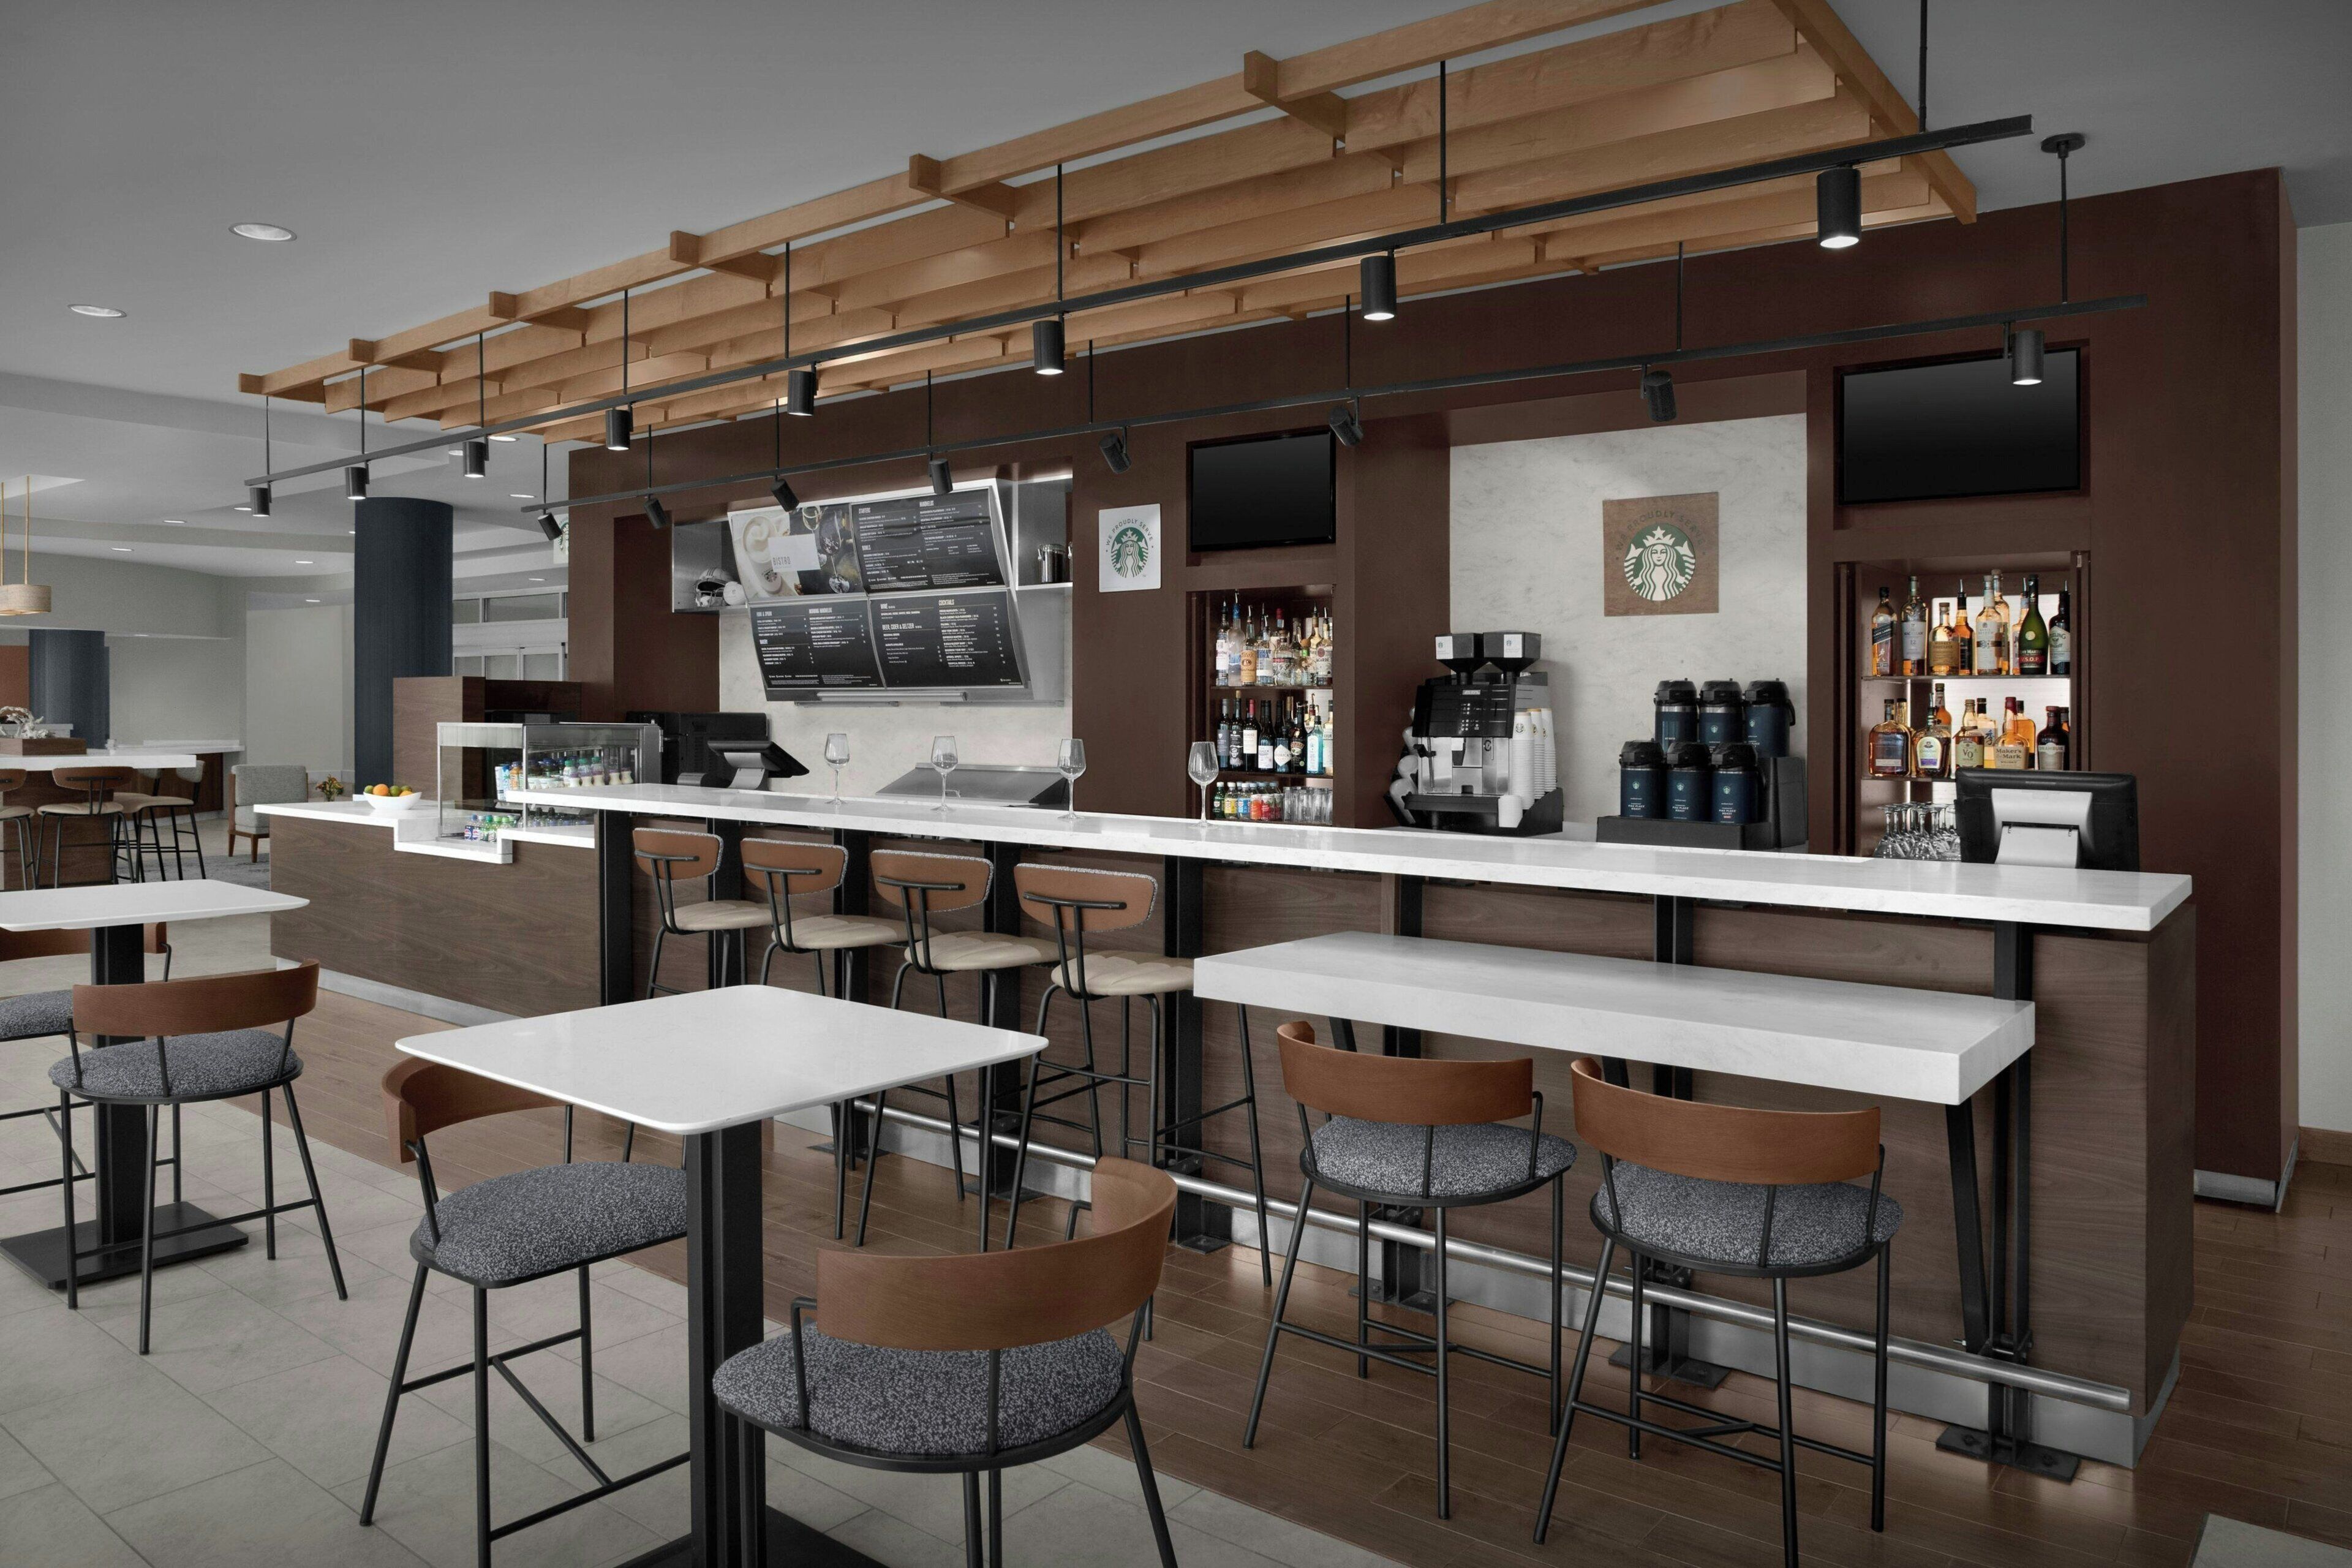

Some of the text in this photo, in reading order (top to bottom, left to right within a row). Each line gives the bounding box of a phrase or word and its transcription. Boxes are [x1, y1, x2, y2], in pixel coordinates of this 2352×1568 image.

[1106, 518, 1153, 546] WE PROUDLY SERVE
[1616, 510, 1703, 551] WE PROUDLY SERVE
[772, 556, 791, 566] BISTRO
[1962, 749, 1973, 758] VO
